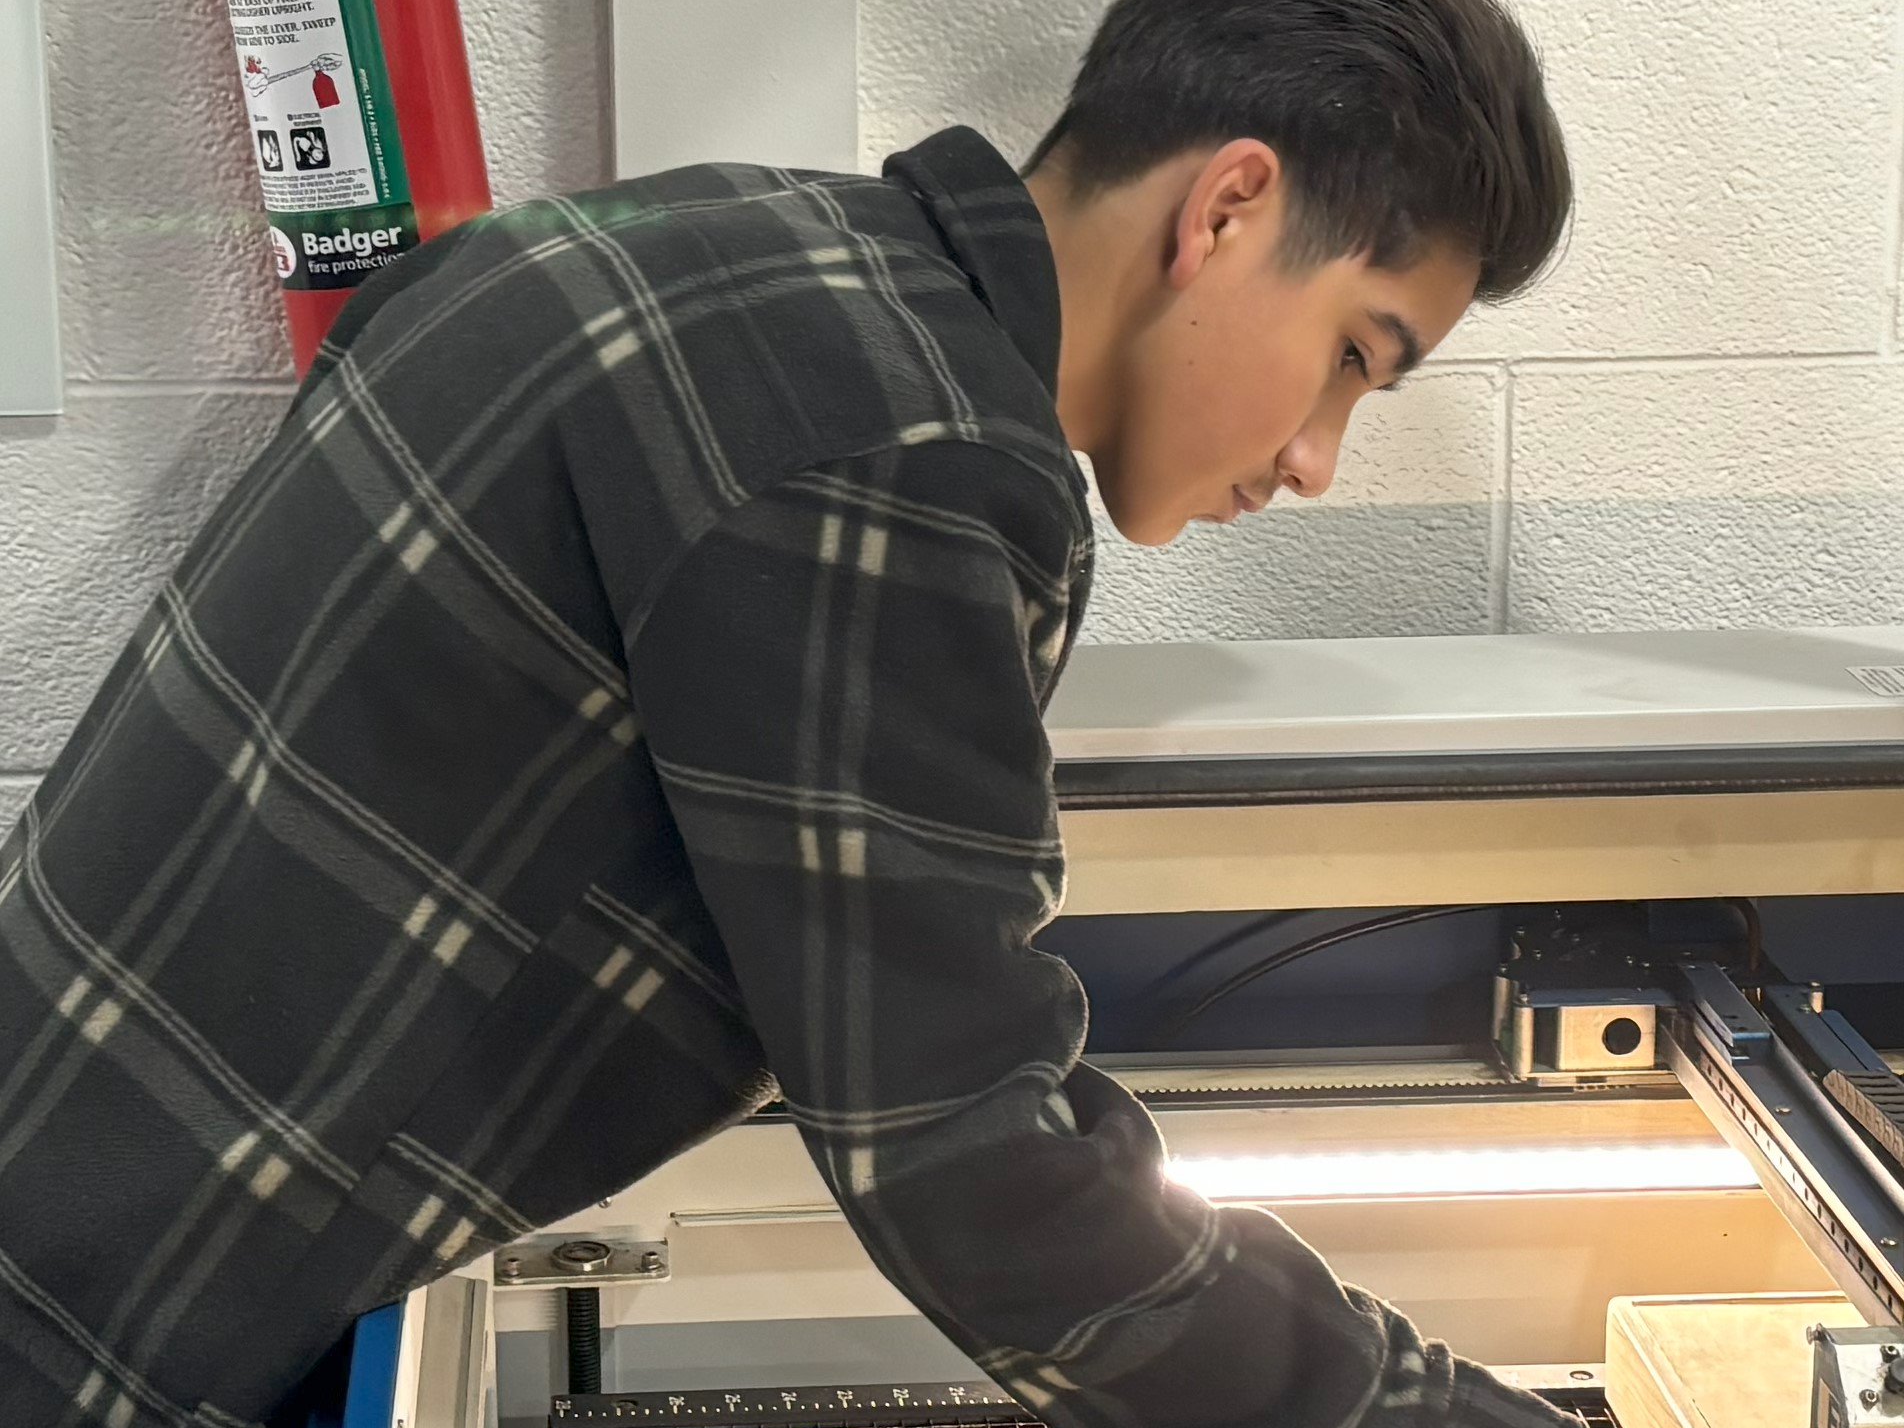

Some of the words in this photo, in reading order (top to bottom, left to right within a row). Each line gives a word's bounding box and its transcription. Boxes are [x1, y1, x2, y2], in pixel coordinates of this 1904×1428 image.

[301, 226, 402, 257] Badger
[308, 260, 330, 274] fire
[332, 252, 405, 275] protectio
